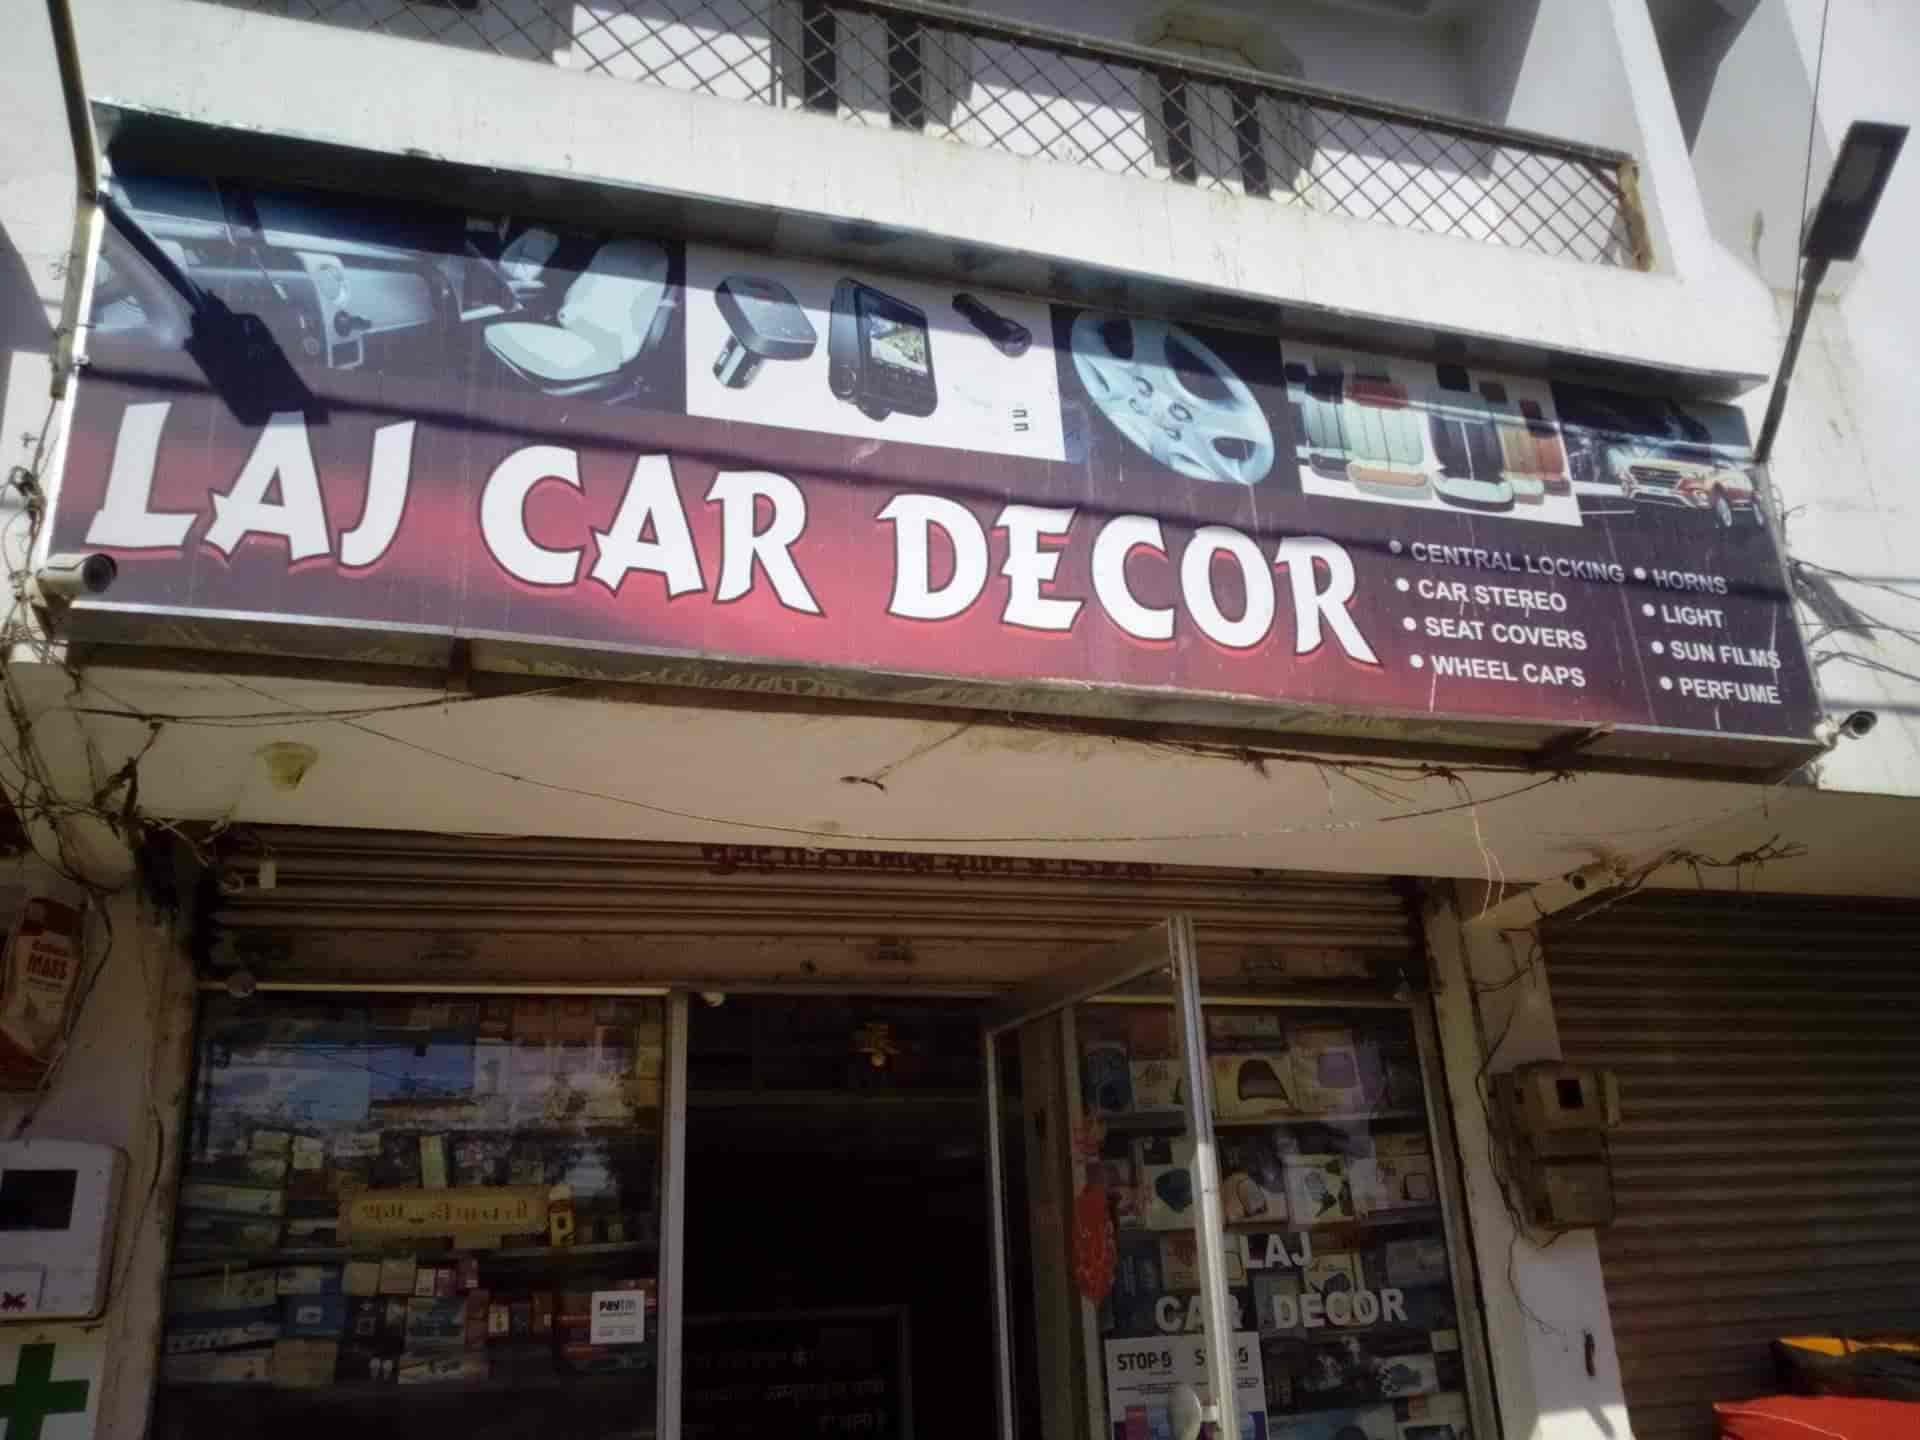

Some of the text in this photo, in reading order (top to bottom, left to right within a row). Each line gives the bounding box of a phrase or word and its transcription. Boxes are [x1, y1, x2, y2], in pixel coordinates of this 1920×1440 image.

[86, 402, 1380, 666] LAJ CAR DECOR
[1410, 541, 1626, 585] CENTRAL LOCKING
[1417, 578, 1567, 613] CAR STEREO
[1653, 567, 1729, 595] HORNS
[1424, 616, 1588, 651] SEAT COVERS
[1662, 604, 1724, 628] LIGHT
[1431, 654, 1587, 688] WHEEL CAPS
[1670, 640, 1782, 670] SUN FILMS
[1679, 677, 1783, 705] PERFUME
[1241, 1232, 1312, 1268] LAJ
[1272, 1288, 1409, 1329] DECOR
